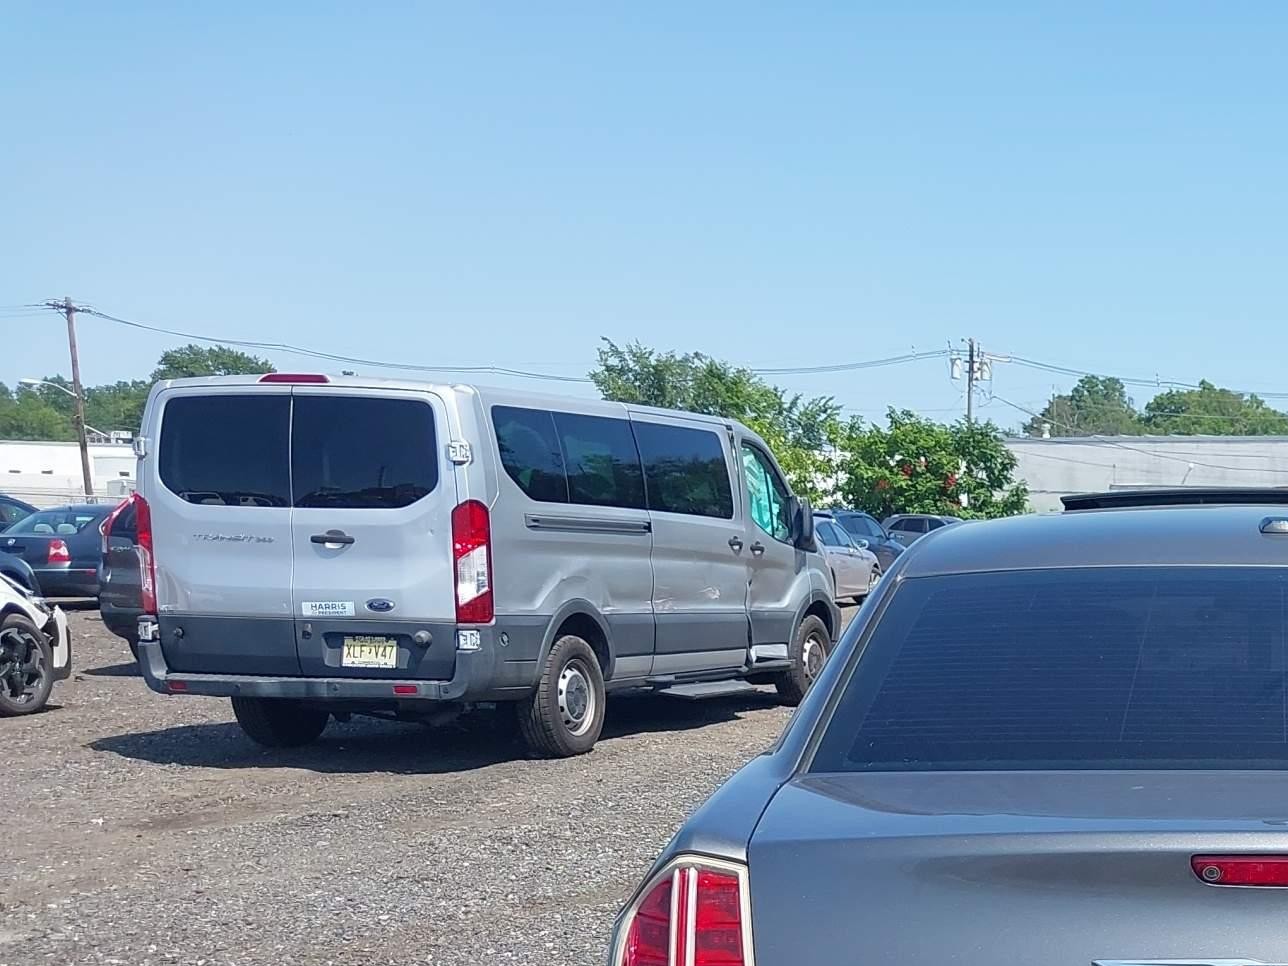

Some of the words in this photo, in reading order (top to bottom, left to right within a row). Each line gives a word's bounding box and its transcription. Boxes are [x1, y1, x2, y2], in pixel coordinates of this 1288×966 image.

[310, 602, 347, 612] HARRIS
[346, 644, 367, 658] XLF
[374, 644, 394, 659] V47
